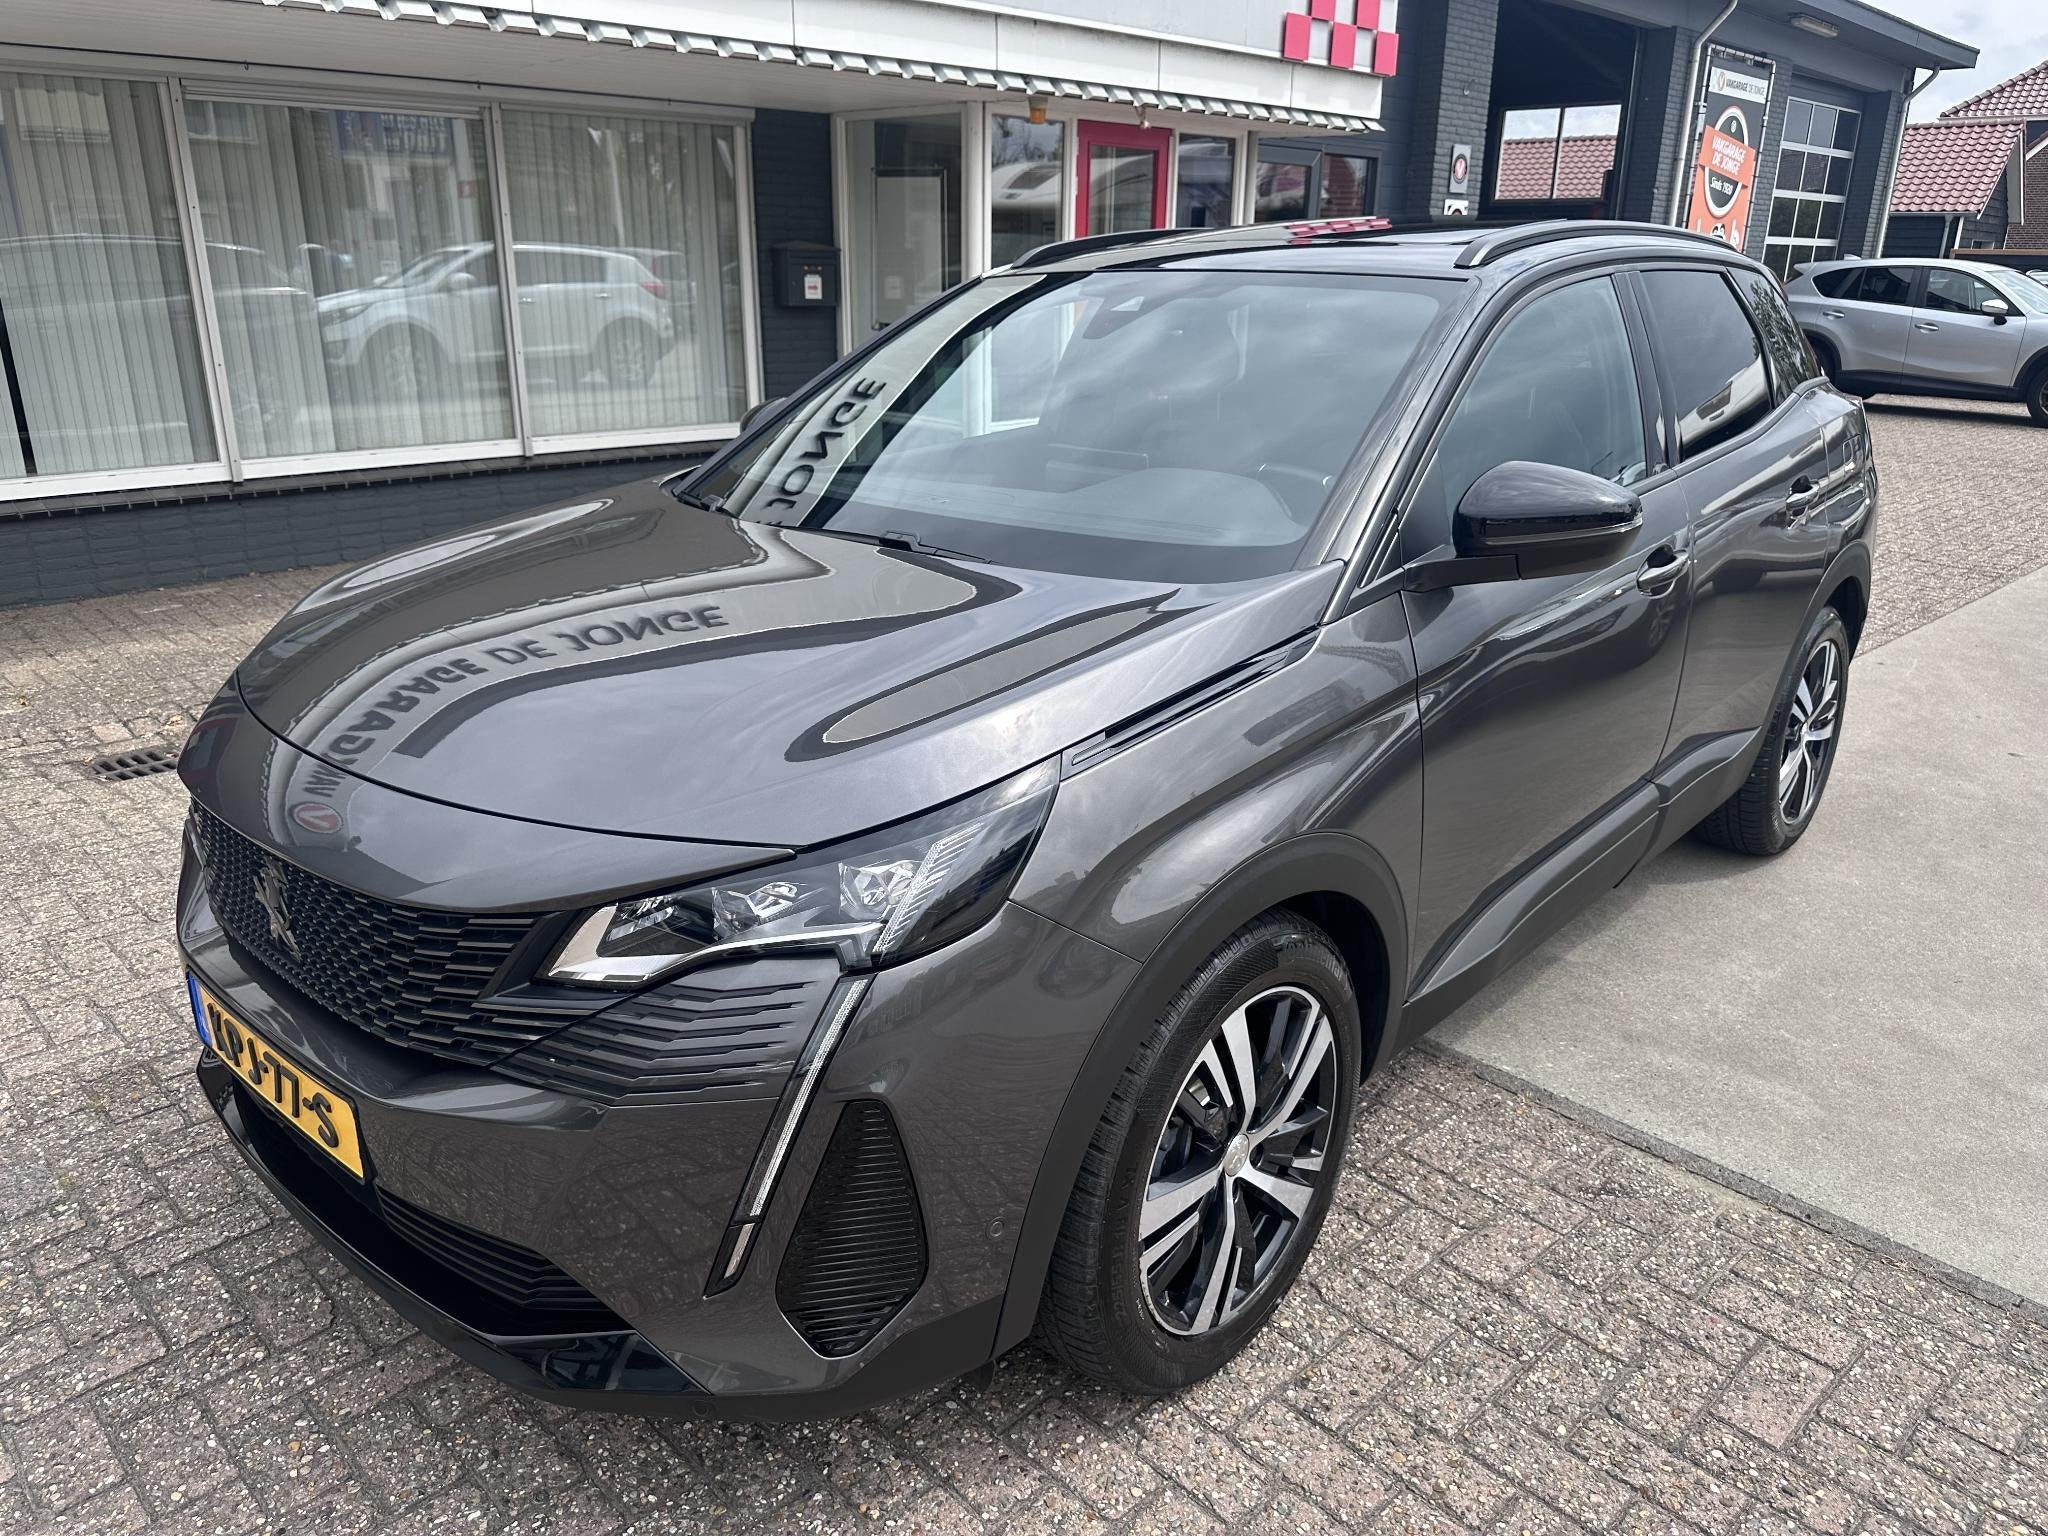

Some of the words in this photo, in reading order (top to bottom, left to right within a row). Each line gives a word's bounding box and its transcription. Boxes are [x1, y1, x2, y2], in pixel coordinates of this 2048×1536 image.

[1711, 135, 1746, 164] VAKGARAGE
[1711, 150, 1721, 167] DE
[206, 1002, 340, 1148] KPJ-77-S
